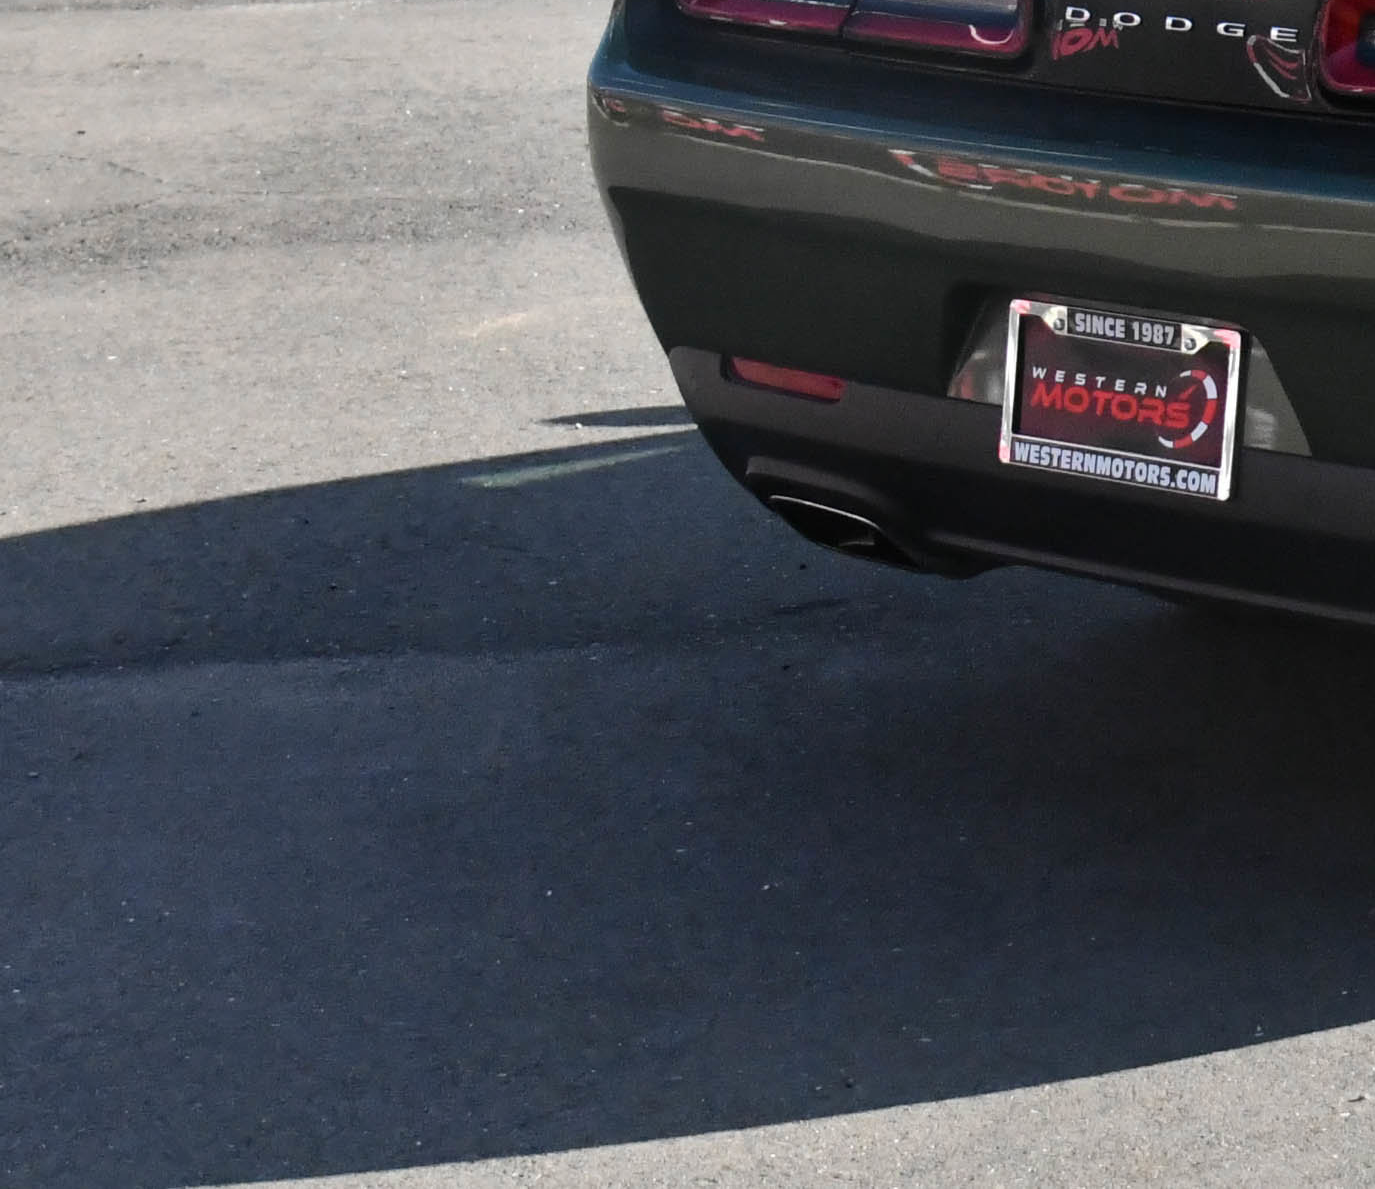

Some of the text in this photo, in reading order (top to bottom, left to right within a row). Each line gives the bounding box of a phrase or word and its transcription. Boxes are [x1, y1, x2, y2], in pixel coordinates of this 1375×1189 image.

[1065, 5, 1299, 42] DODGE
[1074, 312, 1175, 345] SINCE 1987
[1031, 365, 1169, 398] WESTERN
[1030, 382, 1192, 429] MOTORS
[1014, 441, 1217, 494] WESTERNMOTORS.COM
